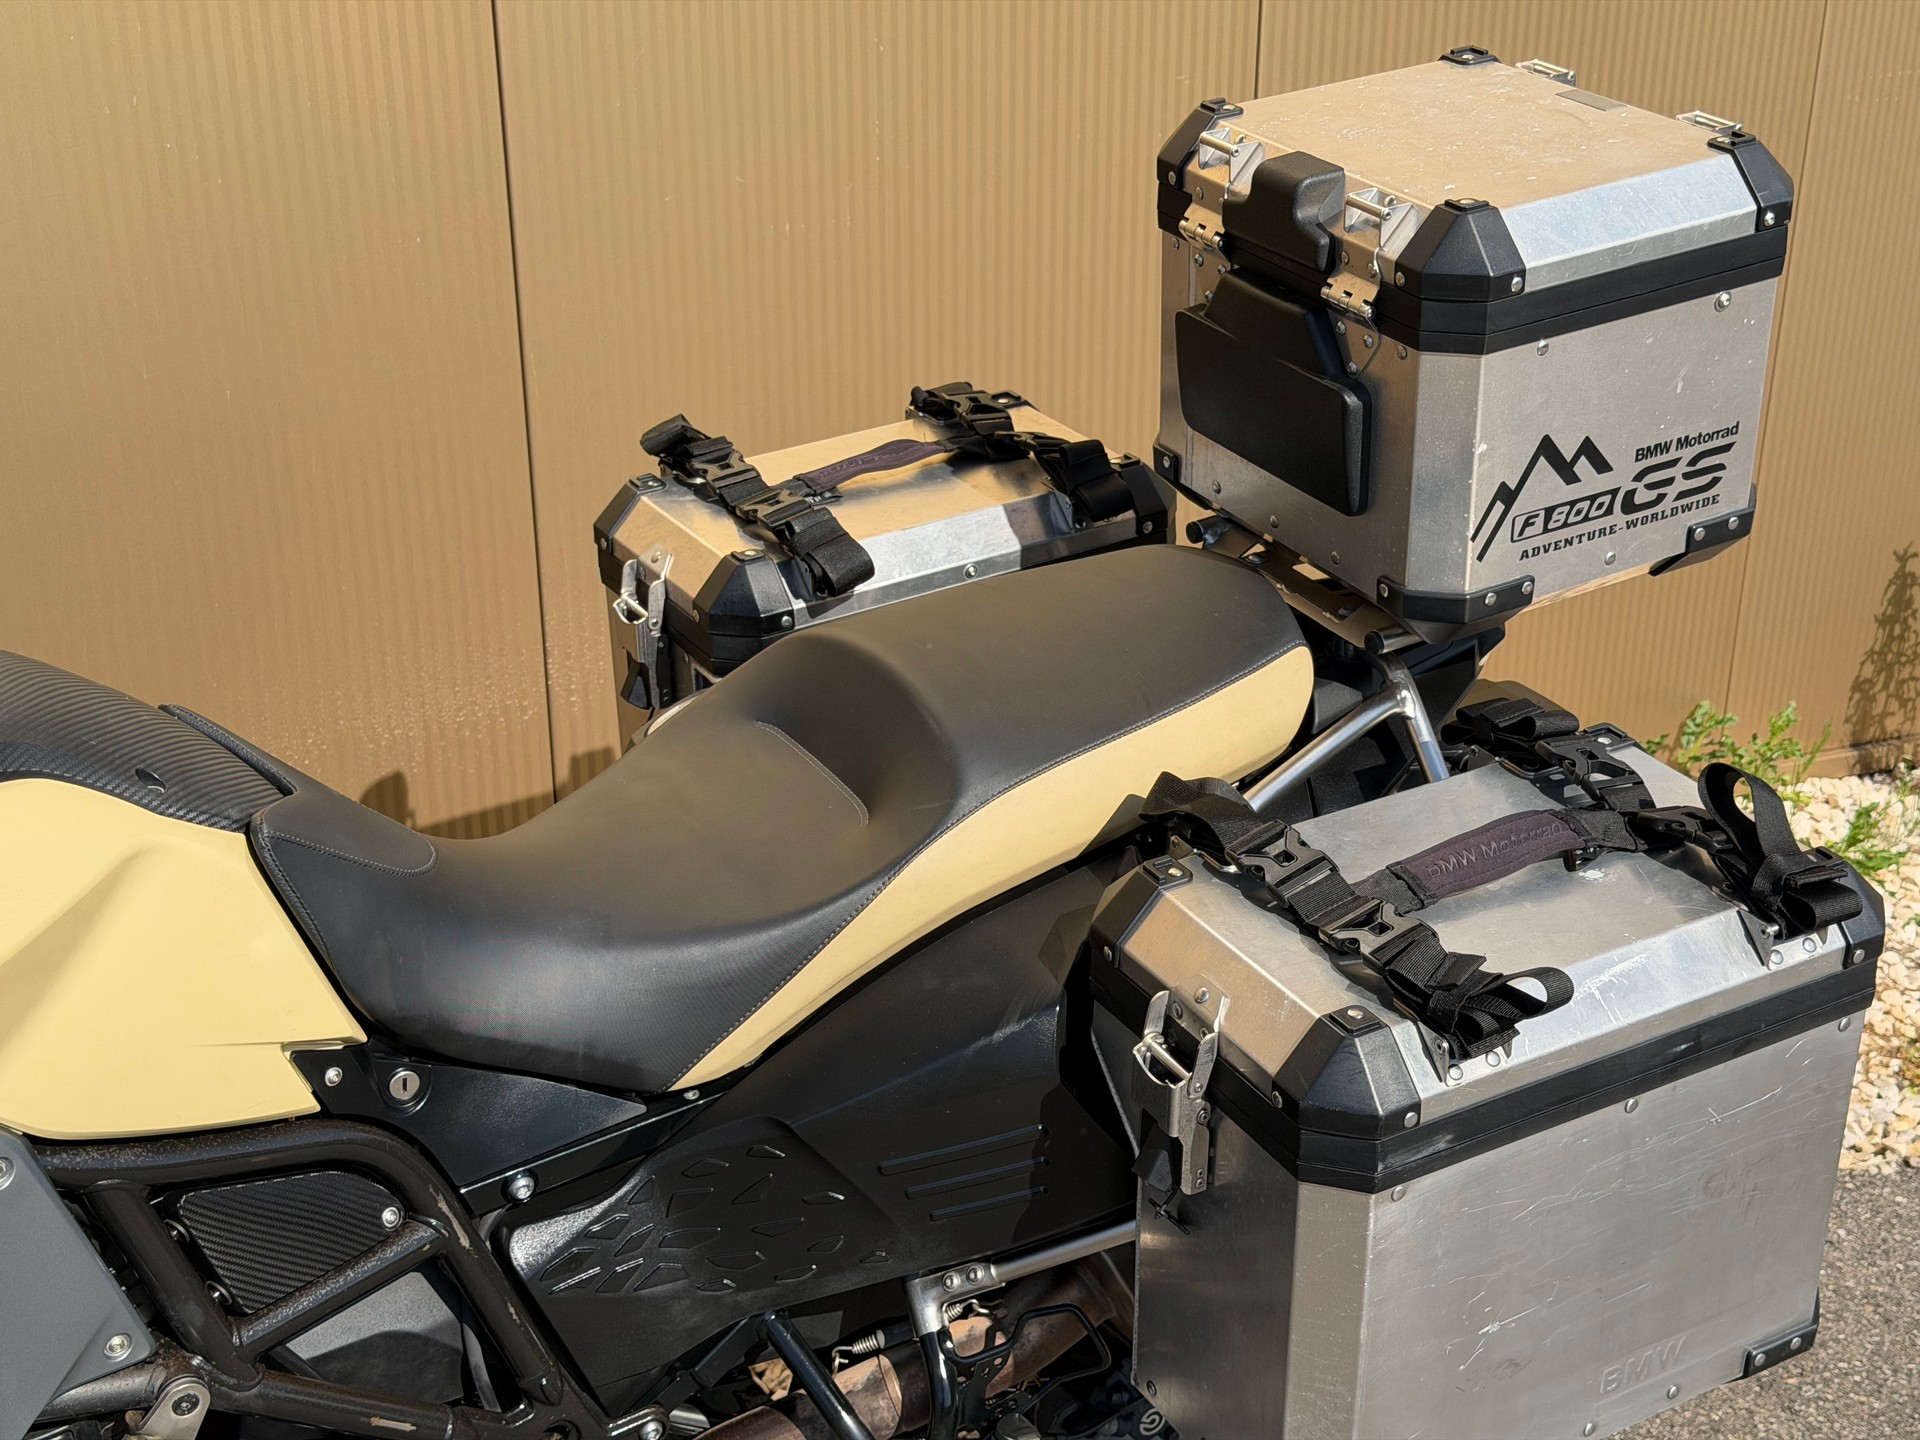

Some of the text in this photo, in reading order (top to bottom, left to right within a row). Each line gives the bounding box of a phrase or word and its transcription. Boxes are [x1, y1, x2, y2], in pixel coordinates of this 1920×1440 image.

[1634, 420, 1740, 464] BMW Motorrad
[1516, 440, 1737, 539] F 800 GS
[1518, 493, 1720, 562] ADVENTURE-WORLDWIDE
[1426, 821, 1564, 878] BMW Motorrad
[1599, 1335, 1687, 1395] BMW
